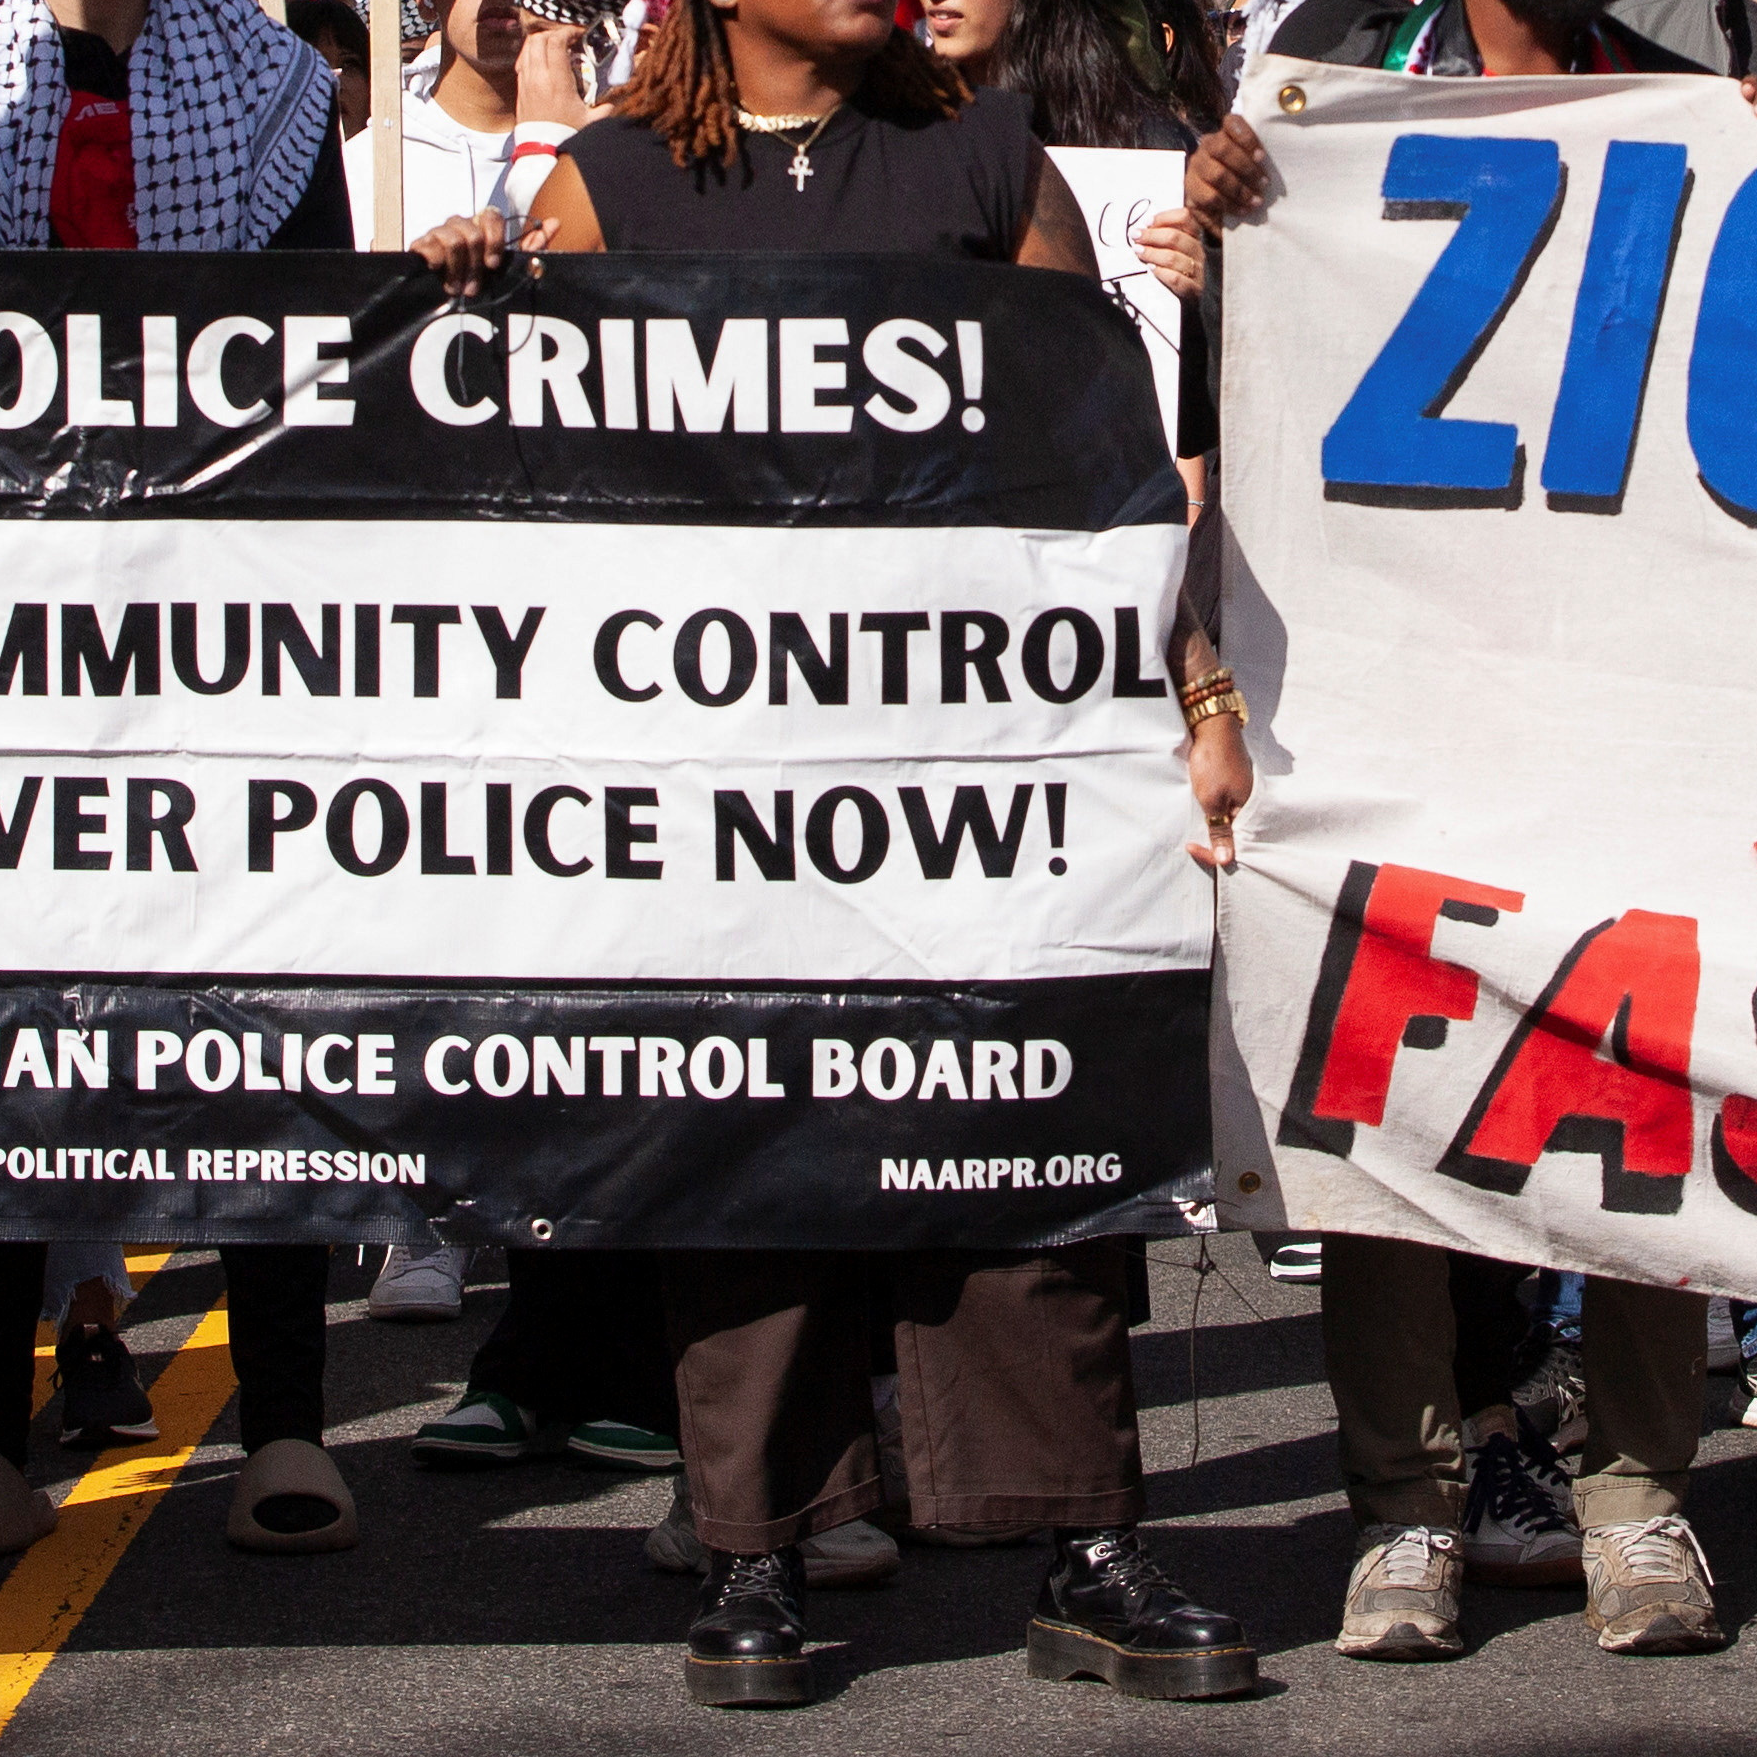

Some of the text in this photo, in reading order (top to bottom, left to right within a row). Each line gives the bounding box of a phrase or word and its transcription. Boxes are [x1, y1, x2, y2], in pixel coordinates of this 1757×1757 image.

[409, 311, 985, 435] CRIMES!
[592, 604, 1168, 710] CONTROL
[247, 775, 665, 882] POLICE
[713, 780, 1070, 886] NOW!
[135, 1027, 397, 1096] POLICE
[423, 1032, 787, 1101] CONTROL
[811, 1036, 1074, 1102] BOARD
[186, 1148, 427, 1187] REPRESSION
[880, 1152, 1123, 1191] NAARPR.ORG
